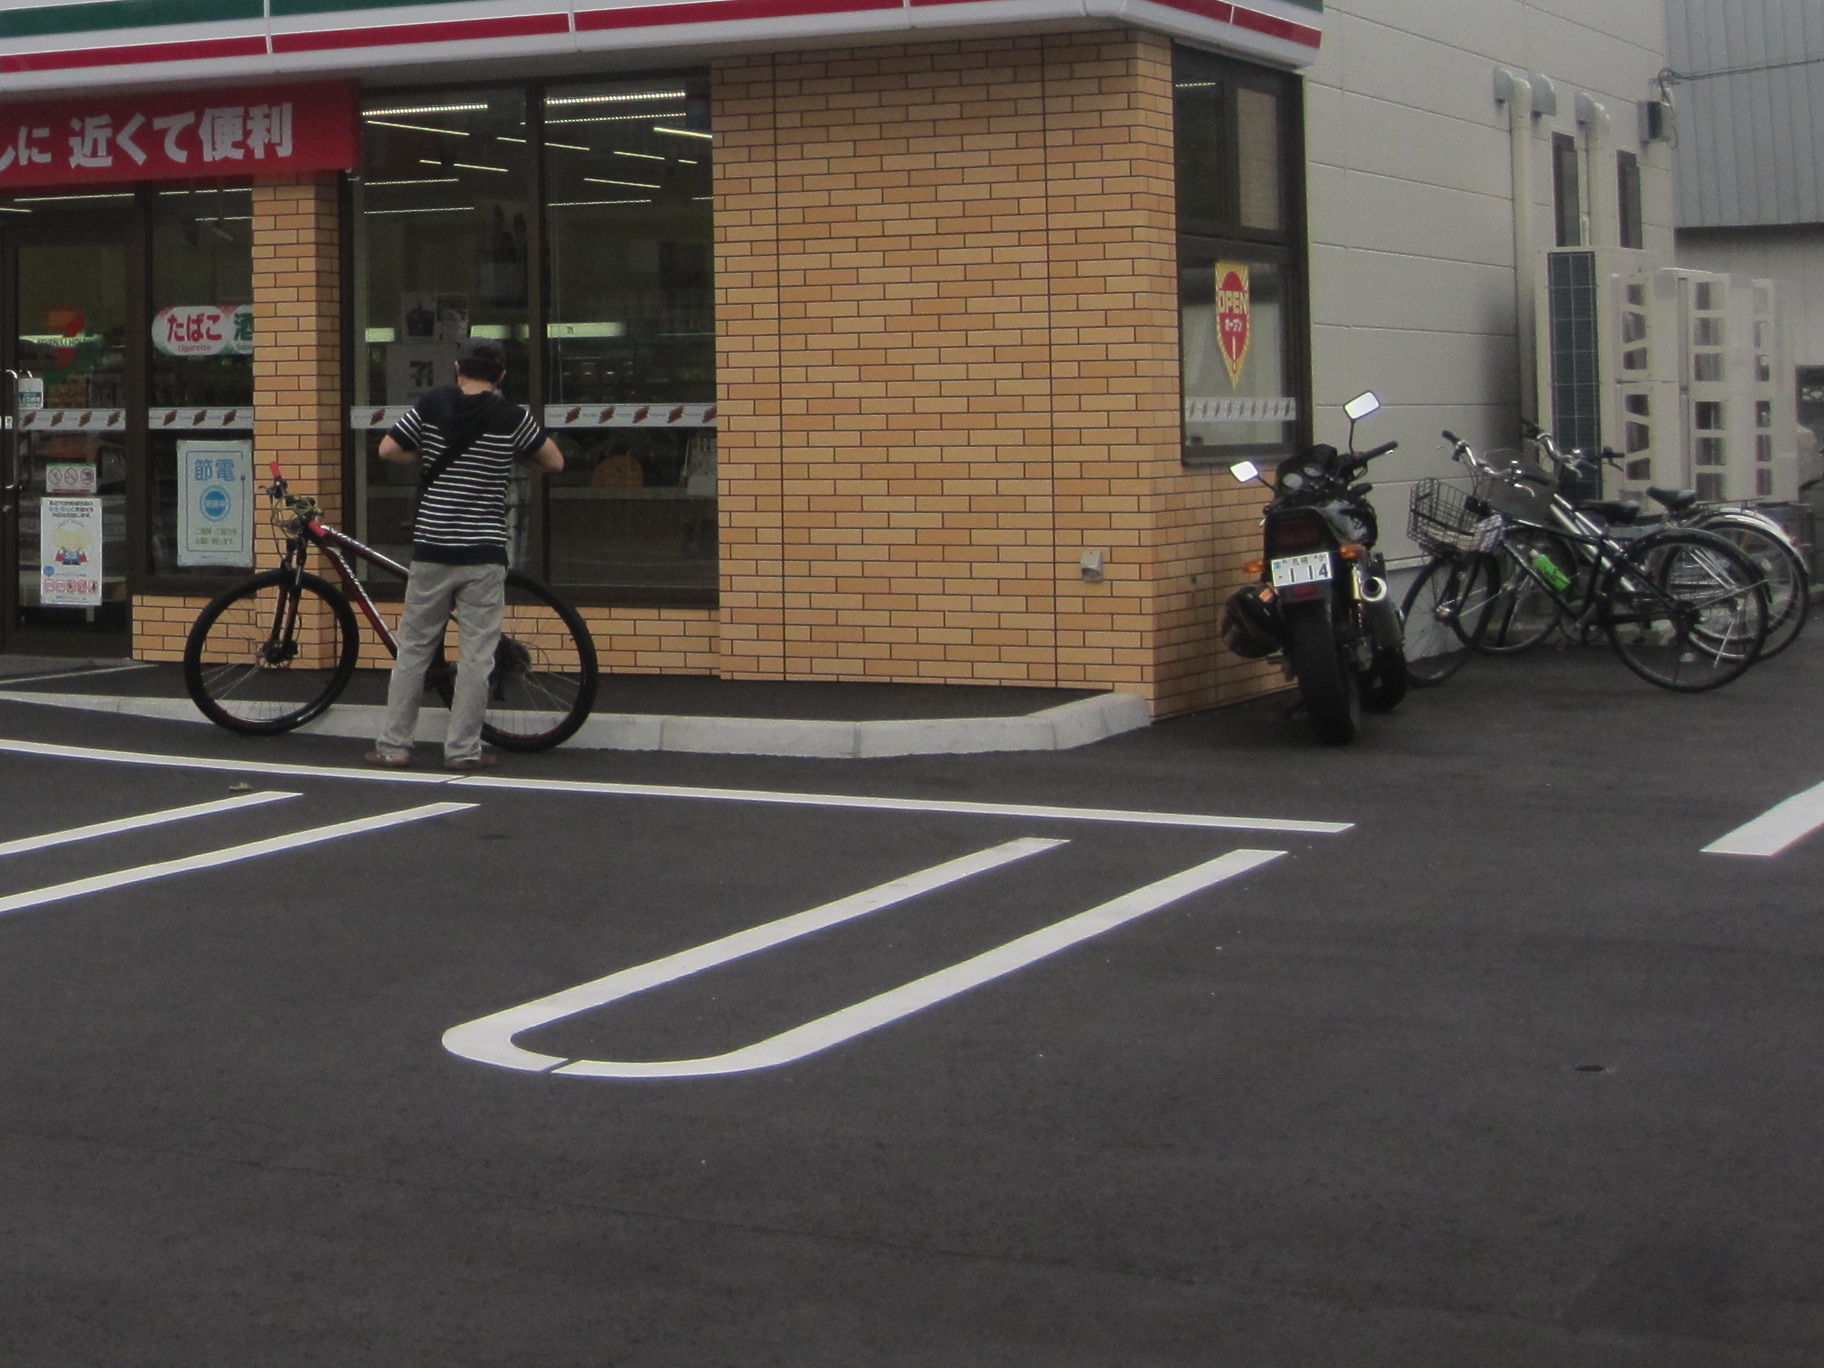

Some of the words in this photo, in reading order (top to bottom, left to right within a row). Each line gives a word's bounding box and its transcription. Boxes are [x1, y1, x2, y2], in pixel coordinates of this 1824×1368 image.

[68, 102, 293, 170] 近くて便利
[1218, 290, 1249, 314] OPEN
[167, 313, 222, 342] たばこ
[194, 458, 236, 482] 節電
